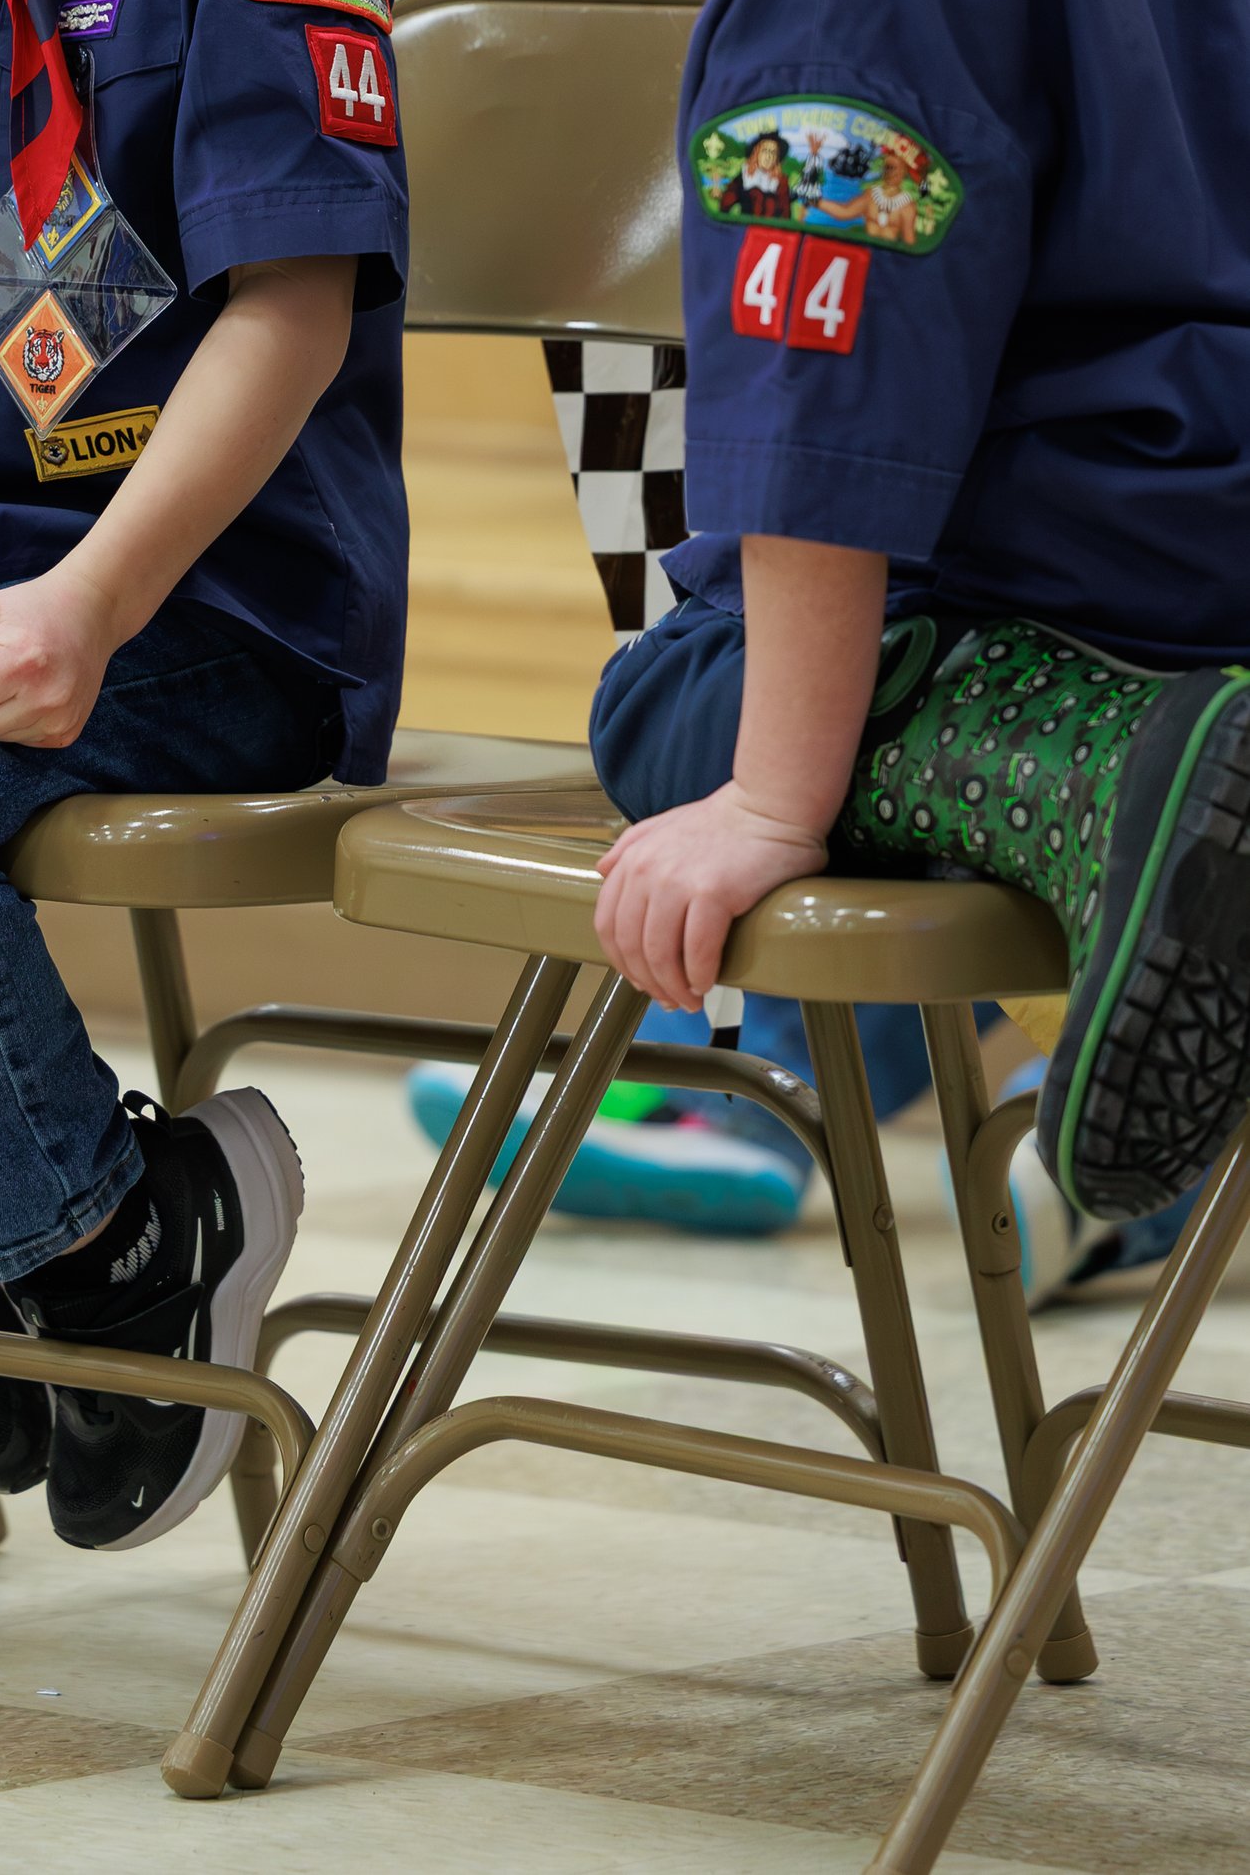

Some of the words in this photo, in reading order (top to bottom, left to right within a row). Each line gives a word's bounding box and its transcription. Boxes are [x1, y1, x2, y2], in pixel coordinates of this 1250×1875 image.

[329, 43, 386, 123] 44
[29, 383, 56, 395] TIGER
[70, 427, 137, 461] LION
[214, 1198, 225, 1231] RUNNING
